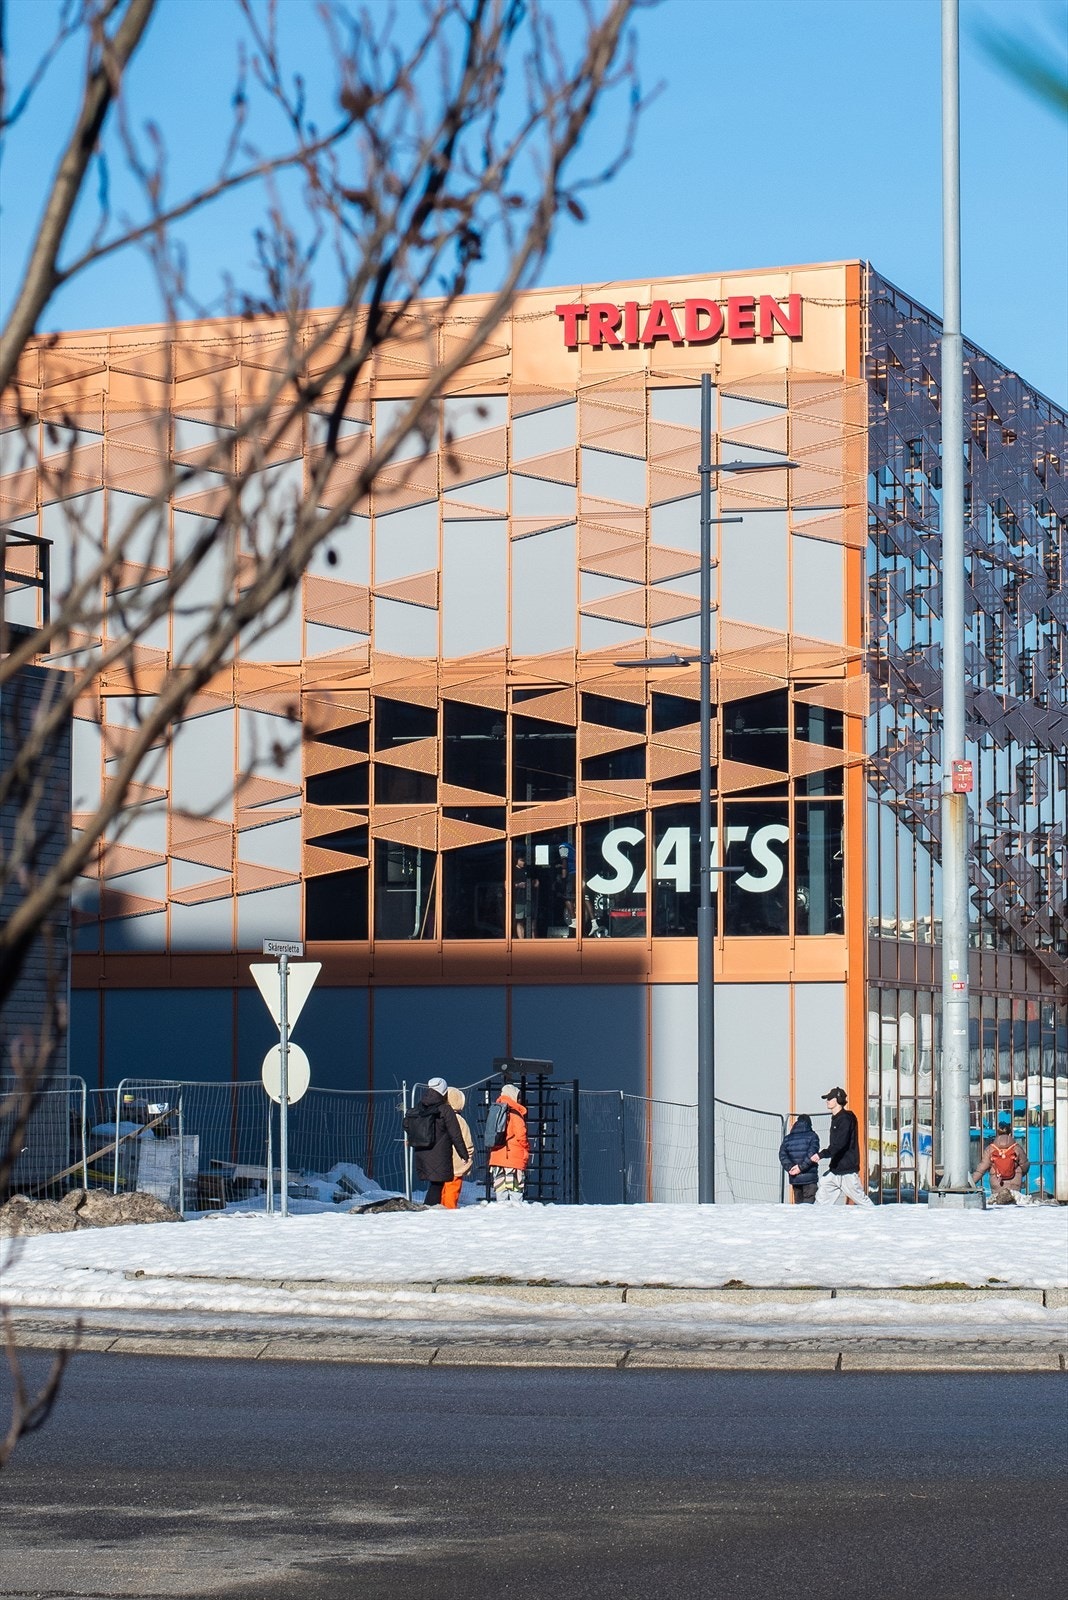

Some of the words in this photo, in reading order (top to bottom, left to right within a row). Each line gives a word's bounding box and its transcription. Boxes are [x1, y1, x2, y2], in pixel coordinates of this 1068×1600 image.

[555, 293, 803, 350] TRIADEN
[587, 824, 790, 894] SATS
[267, 942, 300, 954] Skårersletta
